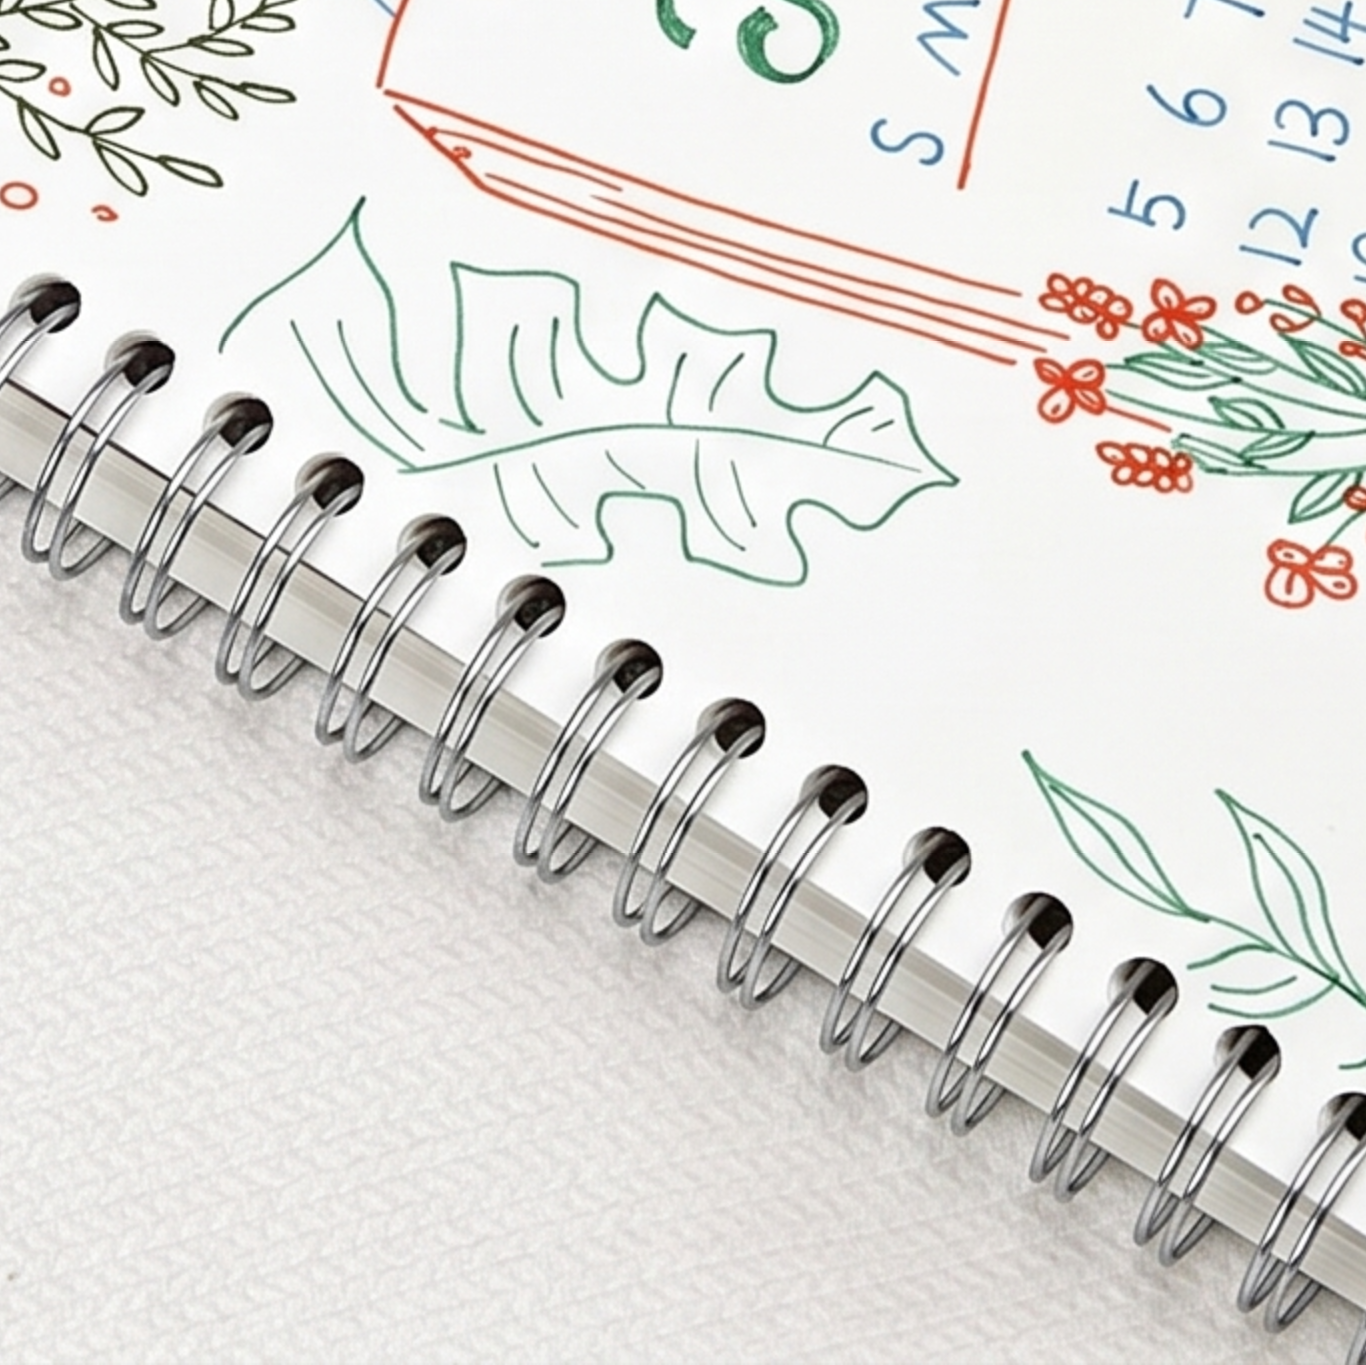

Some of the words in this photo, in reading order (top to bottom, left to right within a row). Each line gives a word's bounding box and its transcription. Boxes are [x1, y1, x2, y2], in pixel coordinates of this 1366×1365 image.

[1145, 84, 1228, 128] 6
[1266, 98, 1351, 164] 13
[870, 118, 945, 167] S
[1106, 178, 1187, 231] 5
[1238, 207, 1320, 268] 12
